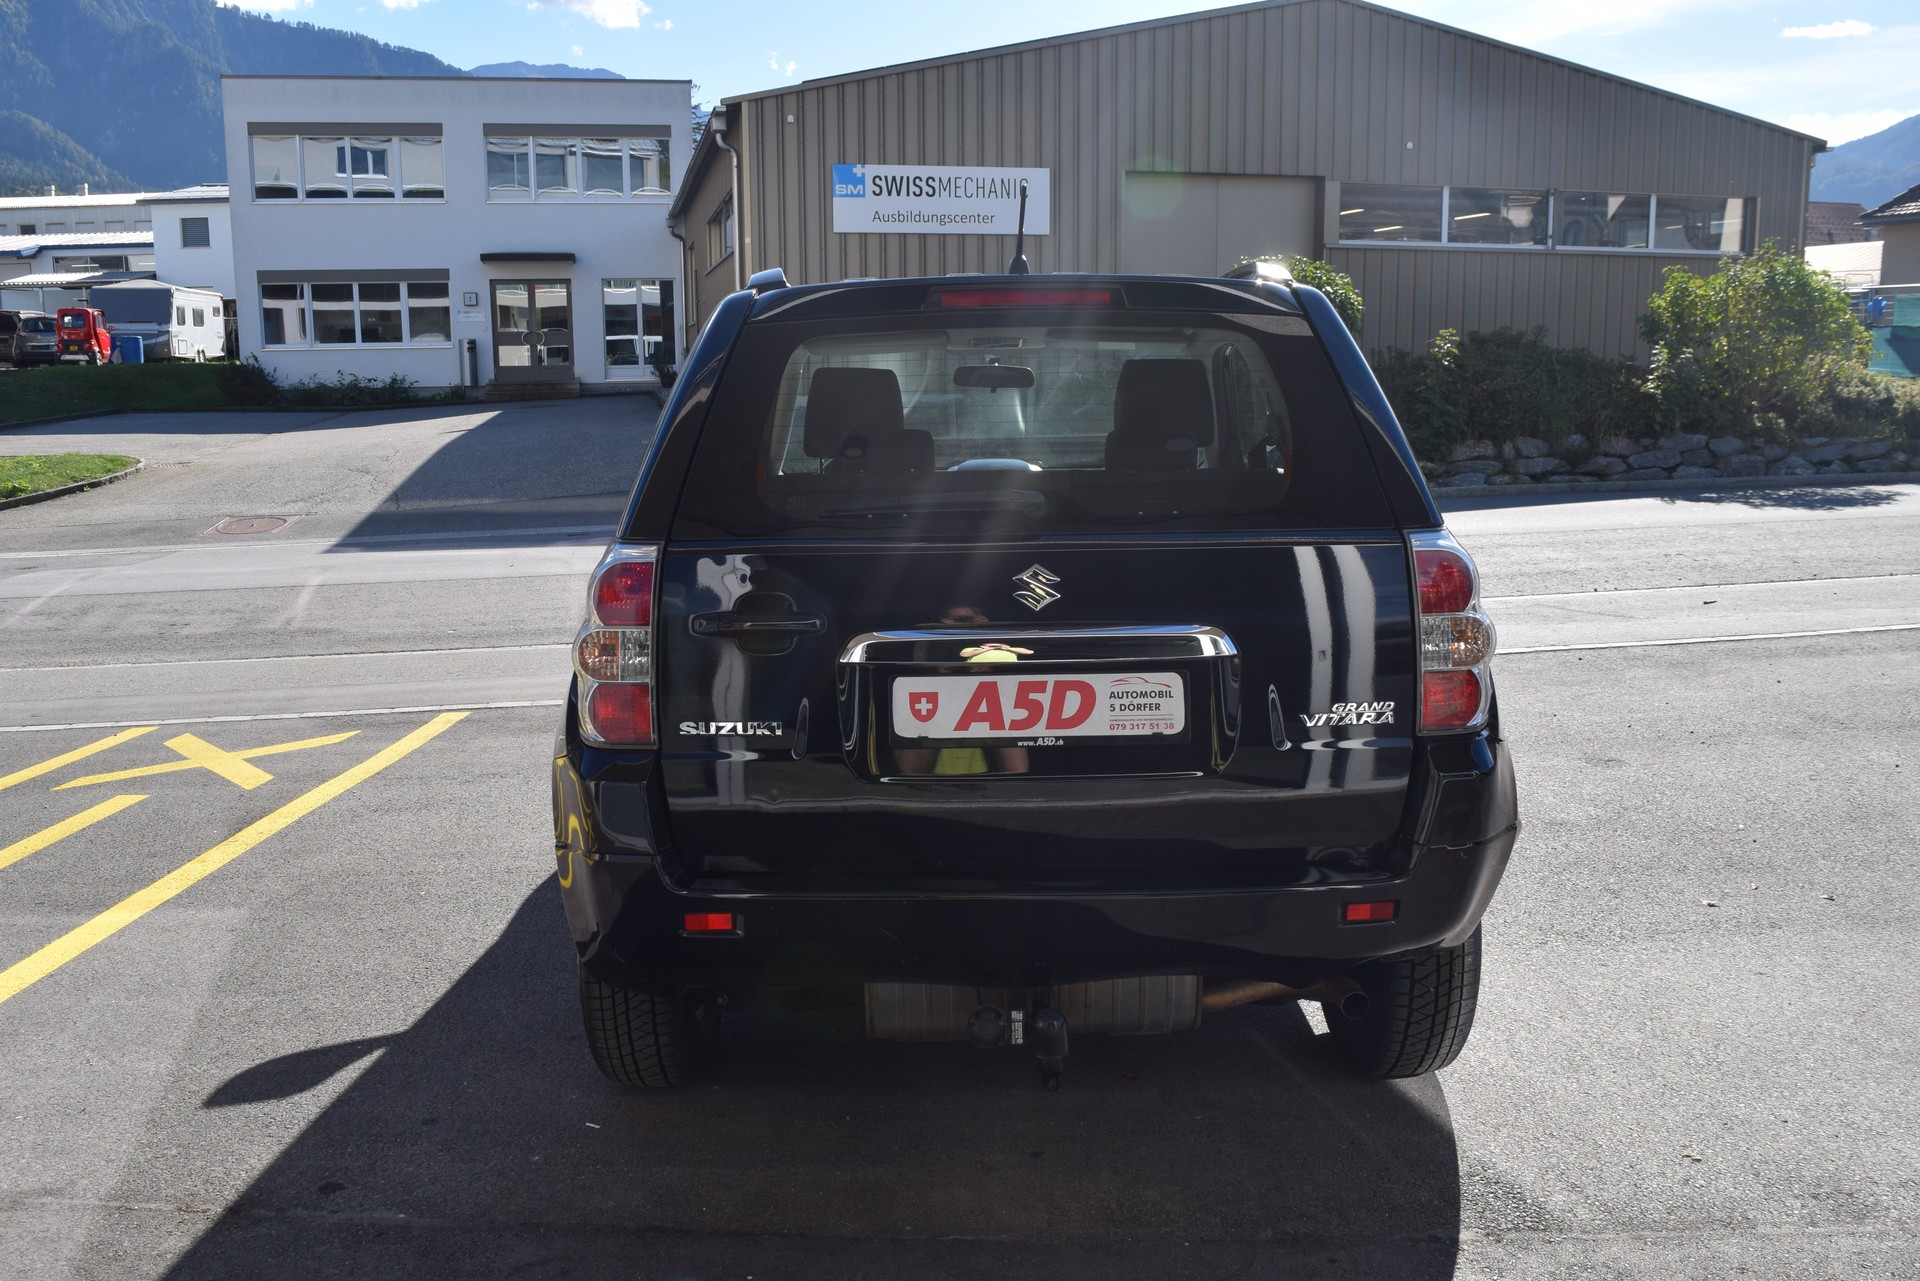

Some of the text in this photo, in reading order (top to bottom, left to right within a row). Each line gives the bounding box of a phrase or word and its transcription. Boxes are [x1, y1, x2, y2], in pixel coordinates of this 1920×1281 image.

[835, 184, 864, 195] SM
[872, 174, 1029, 200] SWISSMECHANIC
[872, 210, 996, 226] Ausbildungscenter
[1109, 690, 1174, 700] AUTOMOBIL
[953, 680, 1097, 732] A5D
[1109, 701, 1161, 712] 5 DÖRFER
[1331, 701, 1395, 713] GRAND
[1299, 711, 1395, 727] VITARA
[679, 721, 783, 737] SUZUKI
[1109, 723, 1127, 731] 079
[1149, 722, 1160, 730] 51
[1163, 722, 1175, 730] 38
[1017, 737, 1064, 747] www.A5D.ch
